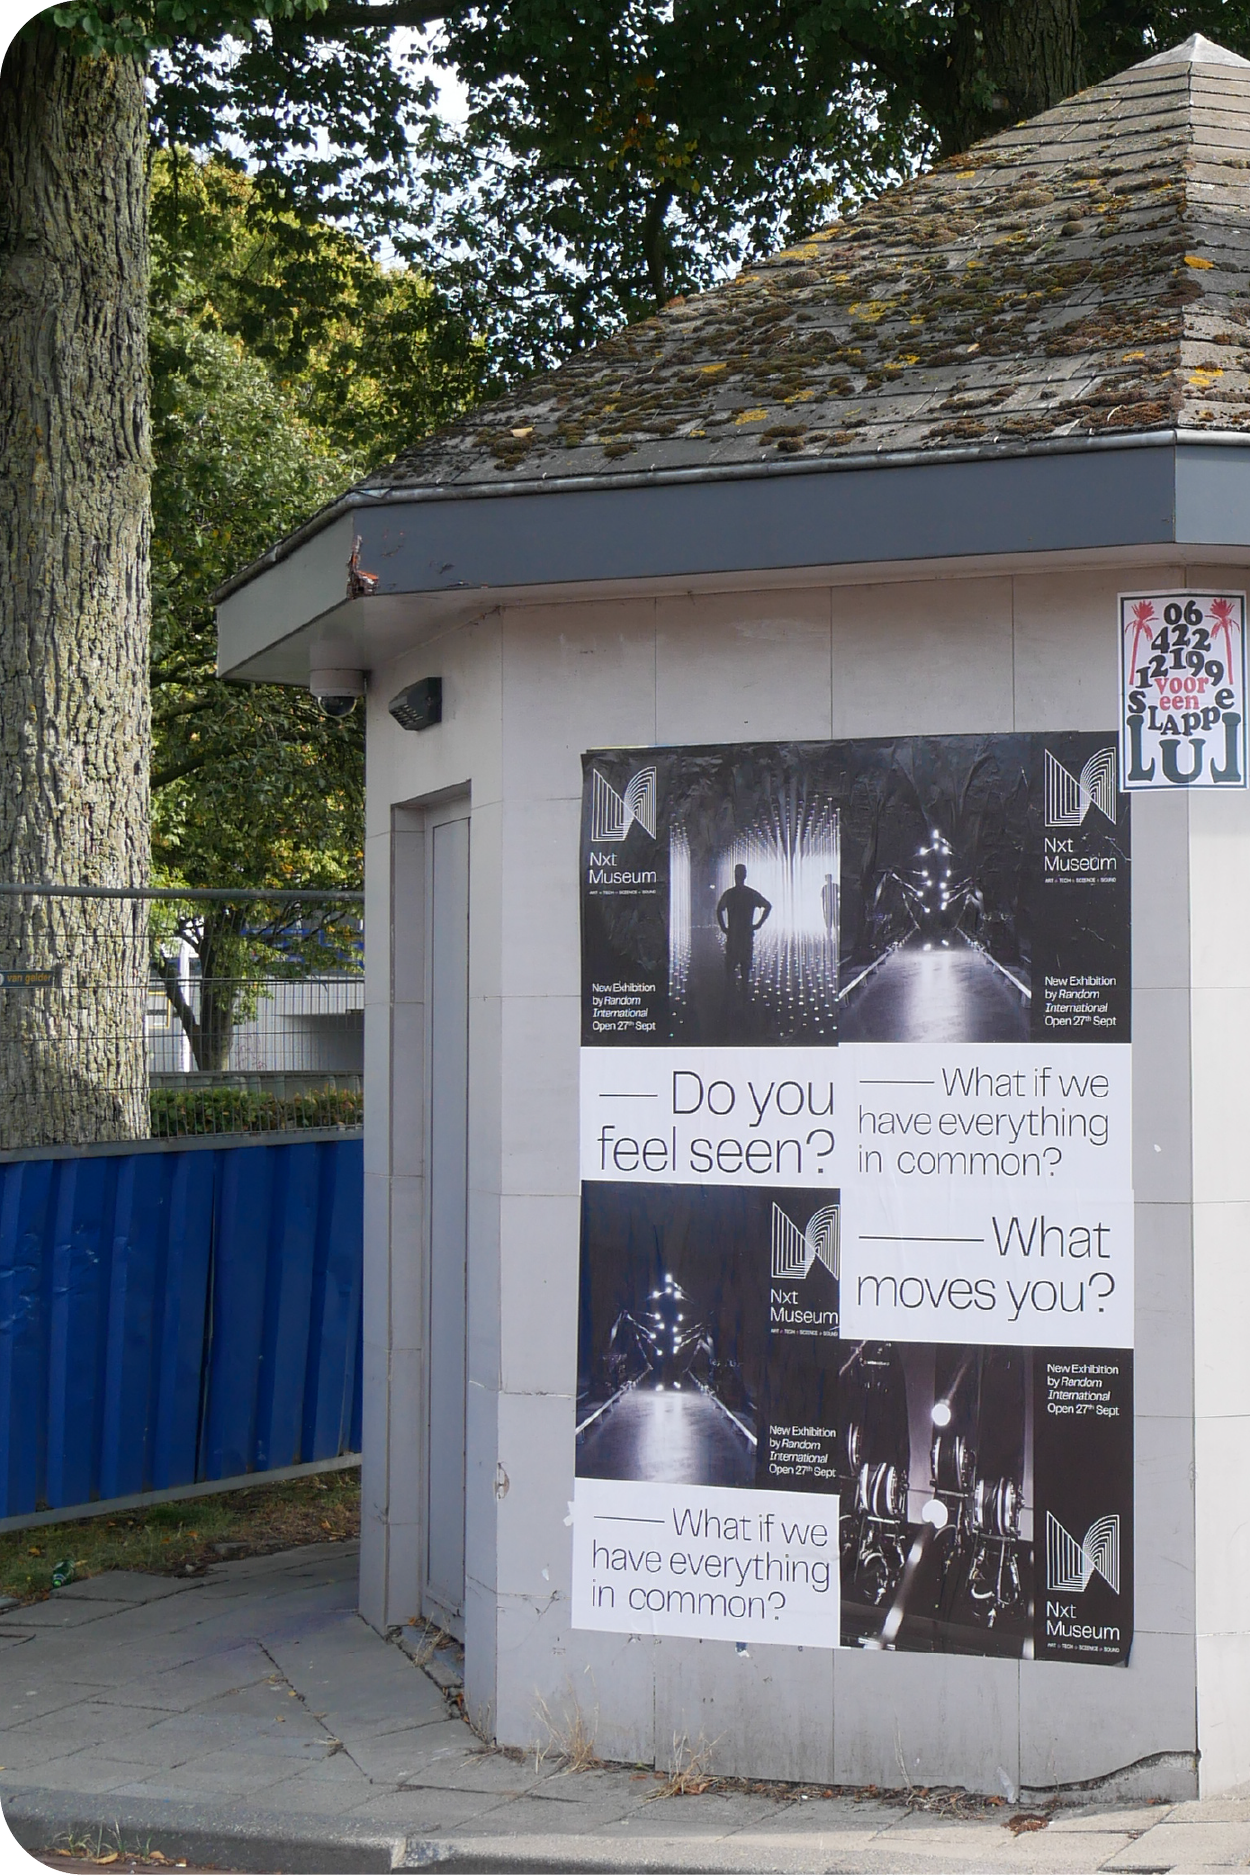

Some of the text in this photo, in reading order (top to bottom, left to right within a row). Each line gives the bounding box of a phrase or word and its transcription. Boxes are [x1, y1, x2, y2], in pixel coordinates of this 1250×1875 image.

[1163, 600, 1203, 626] 06
[1151, 624, 1212, 653] 422
[1136, 647, 1224, 689] 12199
[1154, 677, 1210, 694] voor
[1159, 695, 1200, 711] een
[1044, 837, 1074, 853] Nxt
[589, 852, 618, 866] Nxt
[1044, 855, 1117, 871] Museum
[589, 869, 657, 884] Museum
[7, 972, 52, 985] van gelder
[1045, 976, 1117, 986] New Exhibition
[592, 982, 656, 992] New Exhibition
[1044, 989, 1100, 1001] by Random
[592, 995, 641, 1007] by Random
[1045, 1002, 1108, 1013] International
[592, 1007, 648, 1018] International
[592, 1021, 616, 1032] Open
[635, 1021, 656, 1032] Sept
[1044, 1015, 1072, 1028] Open
[1093, 1015, 1117, 1028] Sept
[942, 1066, 1109, 1098] What if we
[673, 1071, 834, 1127] Do you
[859, 1105, 1109, 1146] have everything
[597, 1126, 835, 1174] feel seen?
[859, 1145, 1062, 1177] in common?
[992, 1215, 1111, 1258] What
[770, 1288, 799, 1304] Nxt
[858, 1272, 1116, 1322] moves you?
[770, 1306, 839, 1324] Museum
[1047, 1363, 1119, 1375] New Exhibition
[1047, 1376, 1103, 1389] by Random
[1048, 1390, 1111, 1402] International
[1047, 1403, 1074, 1416] Open
[1096, 1405, 1120, 1418] Sept
[769, 1425, 837, 1438] New Exhibition
[769, 1437, 821, 1450] by Random
[769, 1451, 829, 1464] International
[769, 1463, 794, 1475] Open
[813, 1466, 836, 1479] Sept
[673, 1507, 828, 1547] What if we
[593, 1539, 829, 1593] have everything
[592, 1579, 786, 1620] in common?
[1047, 1600, 1077, 1619] Nxt
[1047, 1620, 1120, 1640] Museum
